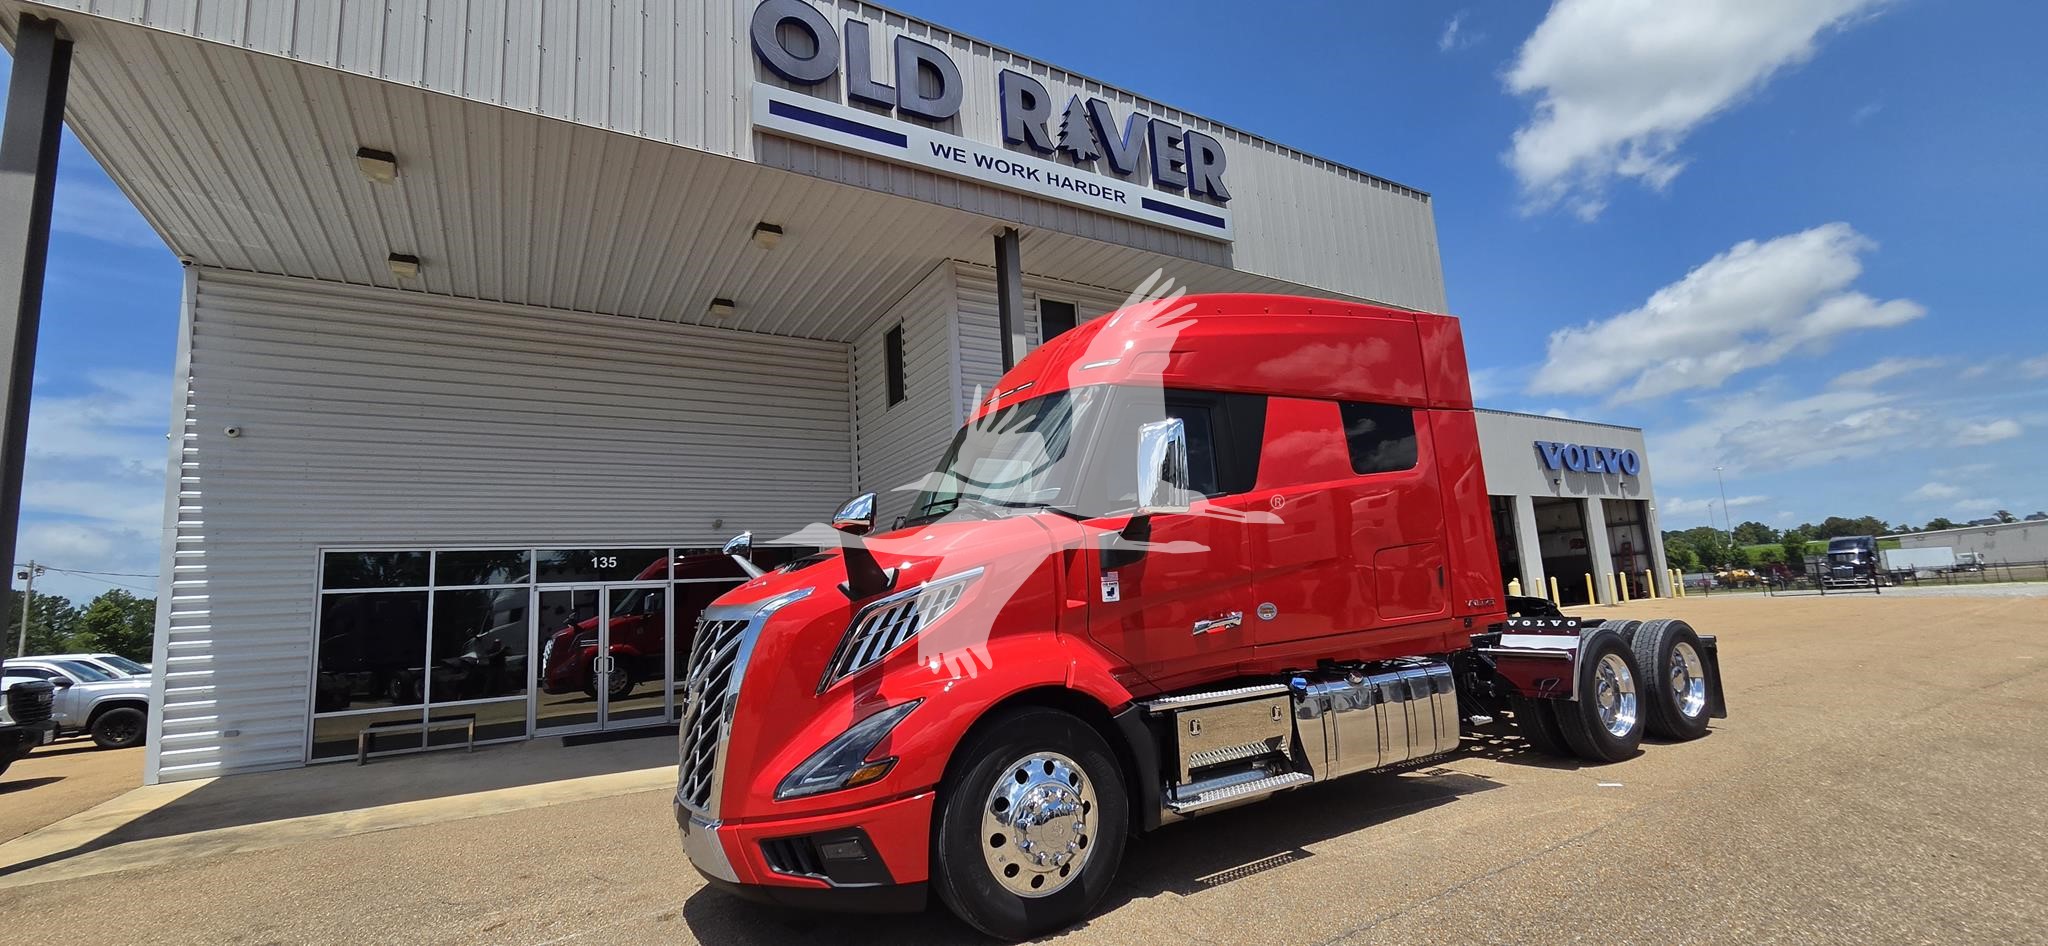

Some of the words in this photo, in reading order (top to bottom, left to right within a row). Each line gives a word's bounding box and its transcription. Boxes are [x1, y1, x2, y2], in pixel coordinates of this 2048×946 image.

[751, 0, 964, 121] OLD
[930, 141, 967, 164] WE
[973, 150, 1041, 183] WORK
[1047, 172, 1127, 205] HARDER
[1534, 441, 1640, 476] VOLVO
[591, 557, 617, 568] 135
